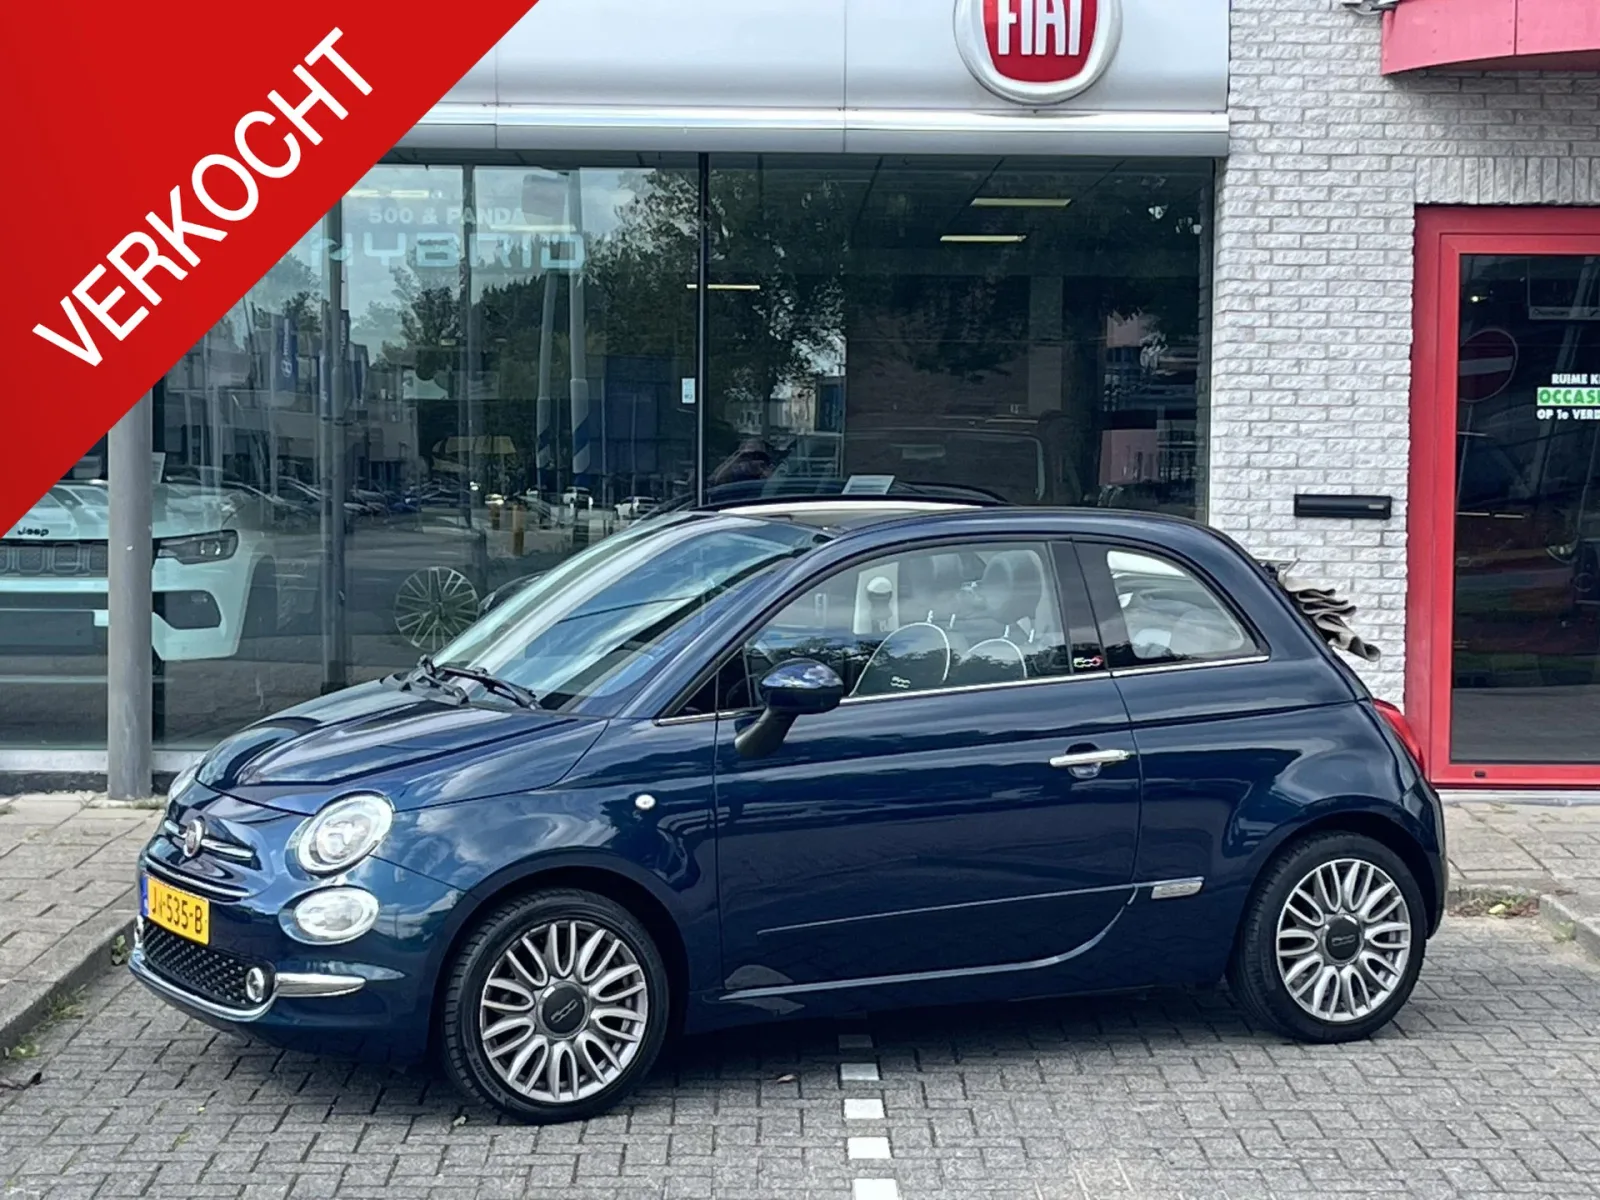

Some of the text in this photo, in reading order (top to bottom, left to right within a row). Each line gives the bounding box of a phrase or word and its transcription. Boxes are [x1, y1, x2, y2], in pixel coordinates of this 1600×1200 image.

[997, 0, 1082, 56] FIAT
[368, 207, 414, 224] 500
[447, 207, 527, 225] PANDA
[1551, 373, 1588, 385] RUIME
[1536, 409, 1554, 420] OP
[17, 526, 49, 537] Jeep
